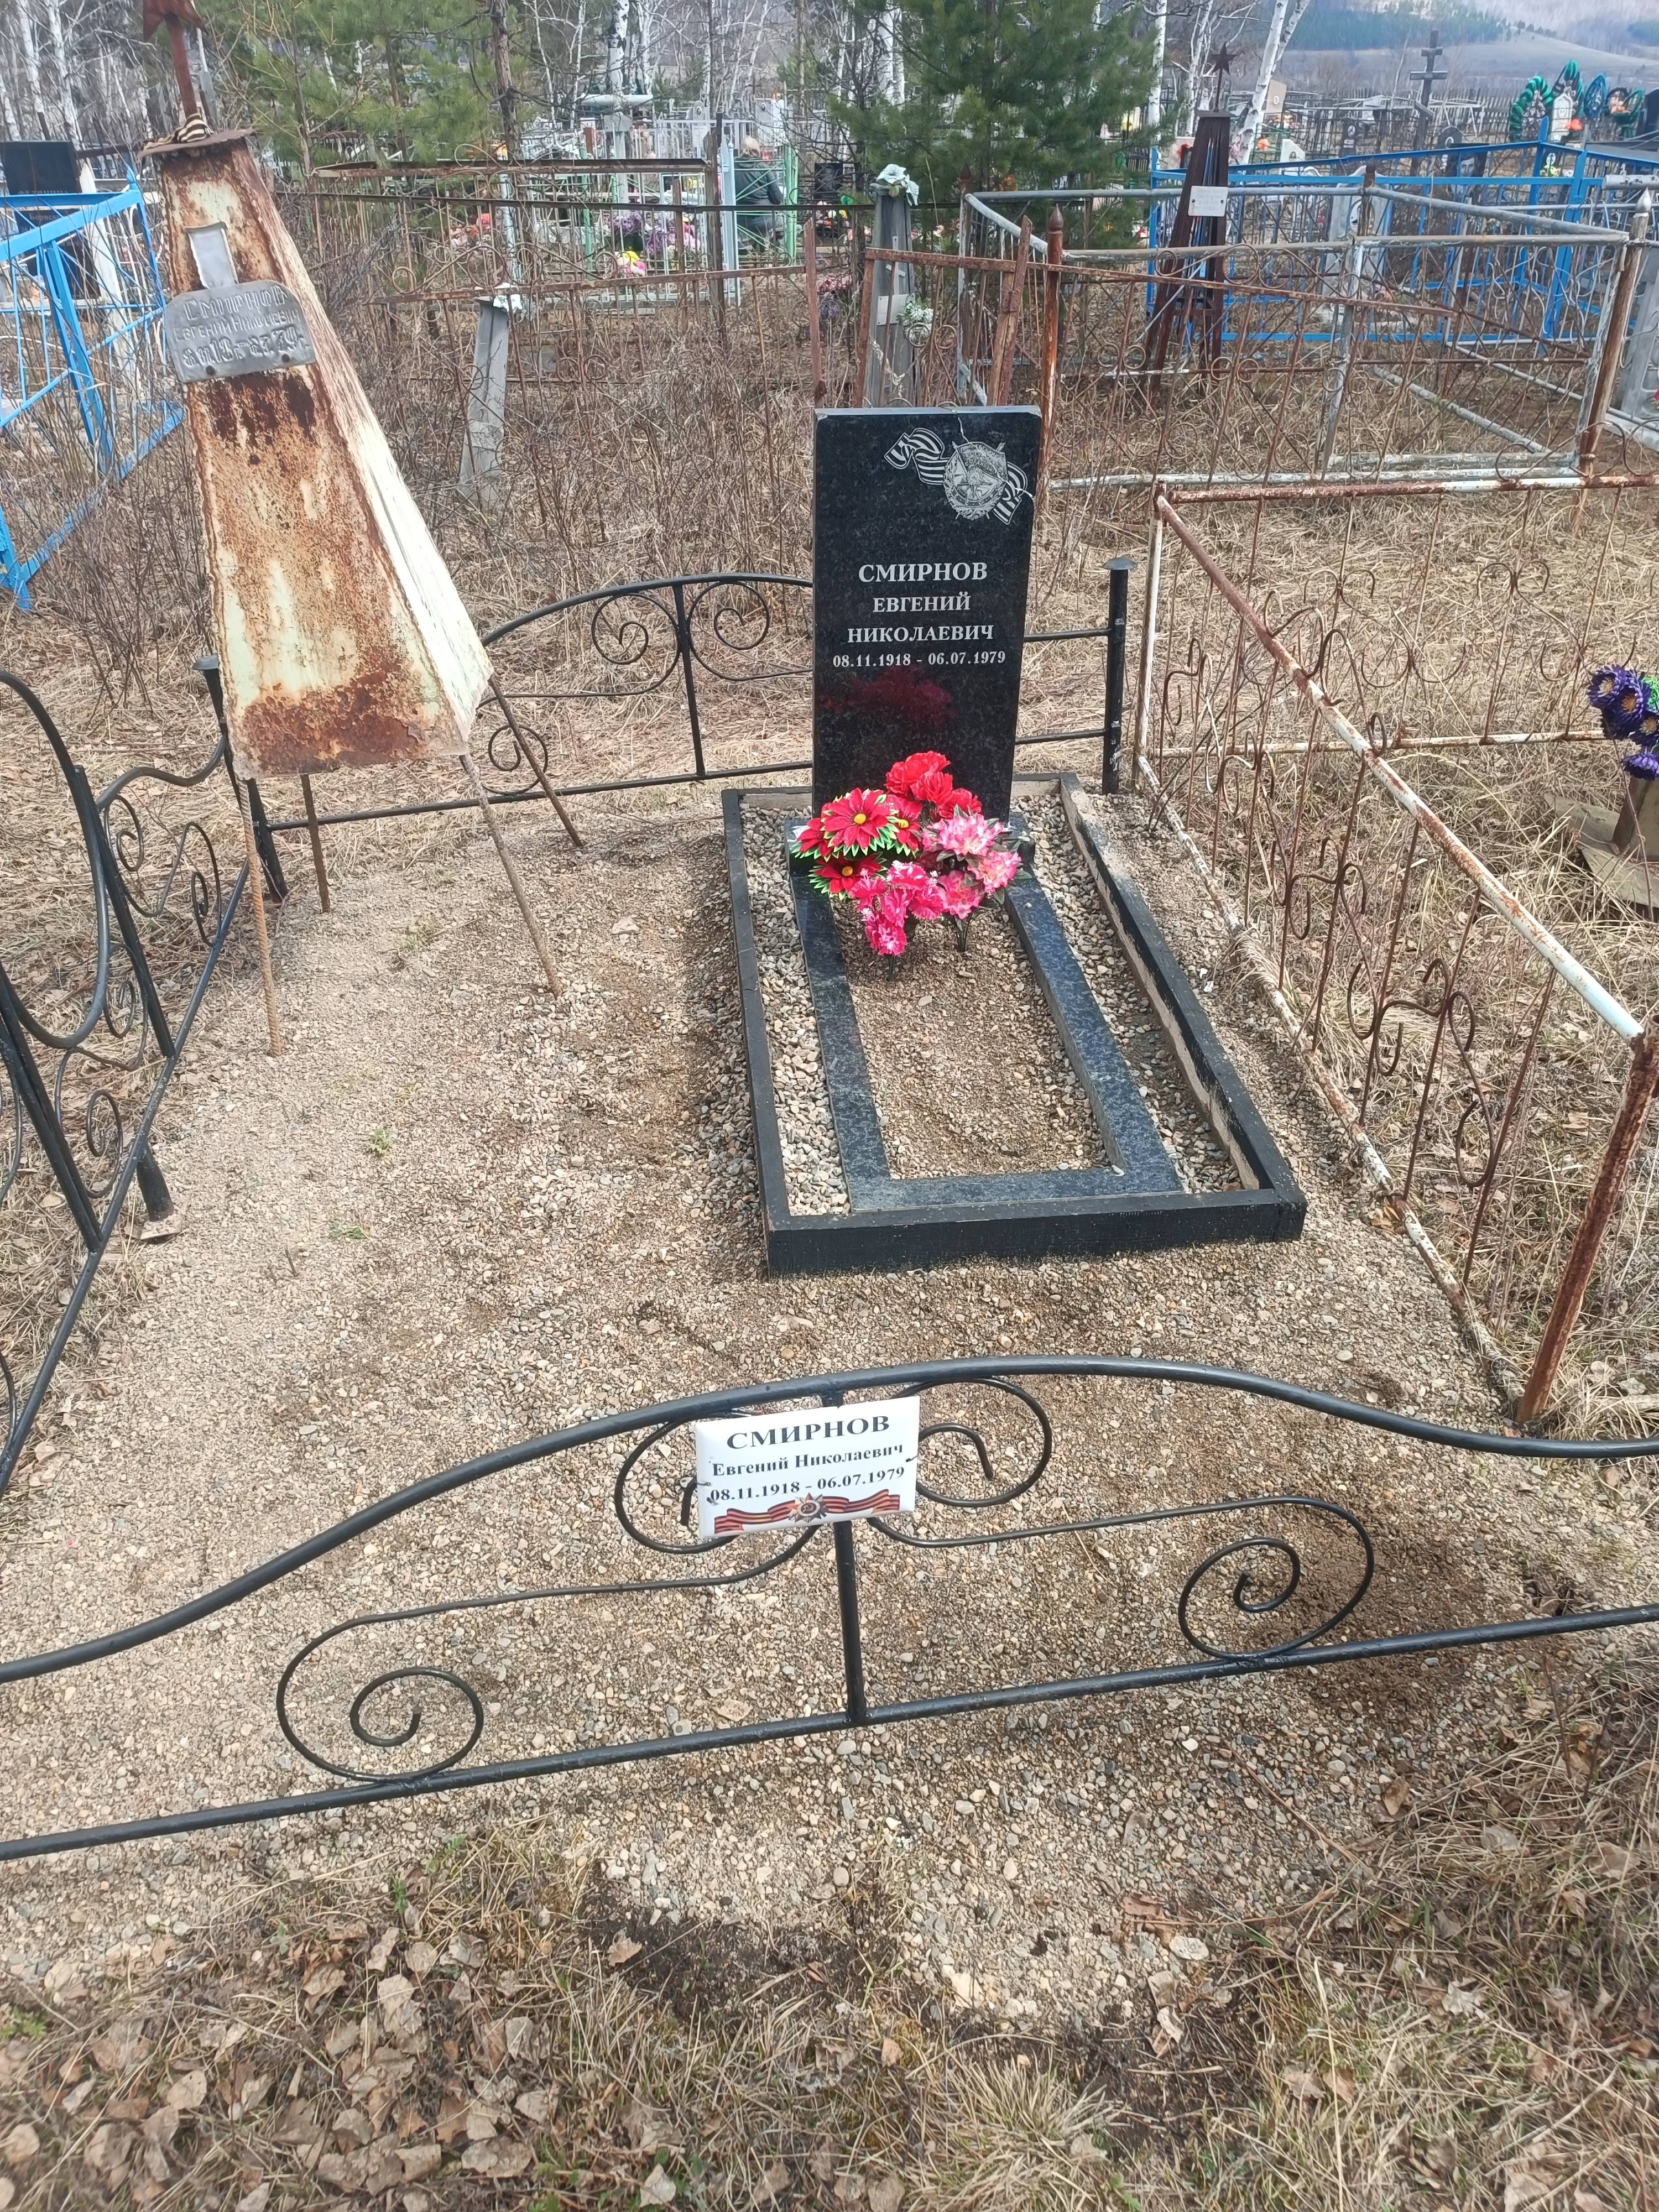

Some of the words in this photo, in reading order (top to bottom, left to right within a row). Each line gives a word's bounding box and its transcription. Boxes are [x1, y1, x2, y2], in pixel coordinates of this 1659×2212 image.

[184, 285, 288, 321] СМИРНОВ
[858, 562, 987, 582] СМИРНОВ
[873, 591, 971, 613] ЕВГЕНИЙ
[847, 625, 994, 643] НИКОЛАЕВИЧ
[832, 653, 911, 667] 08.11.1918
[928, 650, 1006, 665] 06.07.1979
[727, 1416, 889, 1449] СМИРНОВ
[713, 1457, 789, 1477] Евгений
[795, 1443, 904, 1468] Николаевич
[710, 1481, 800, 1501] 08.11.1918
[817, 1466, 905, 1490] 06.07.1979
